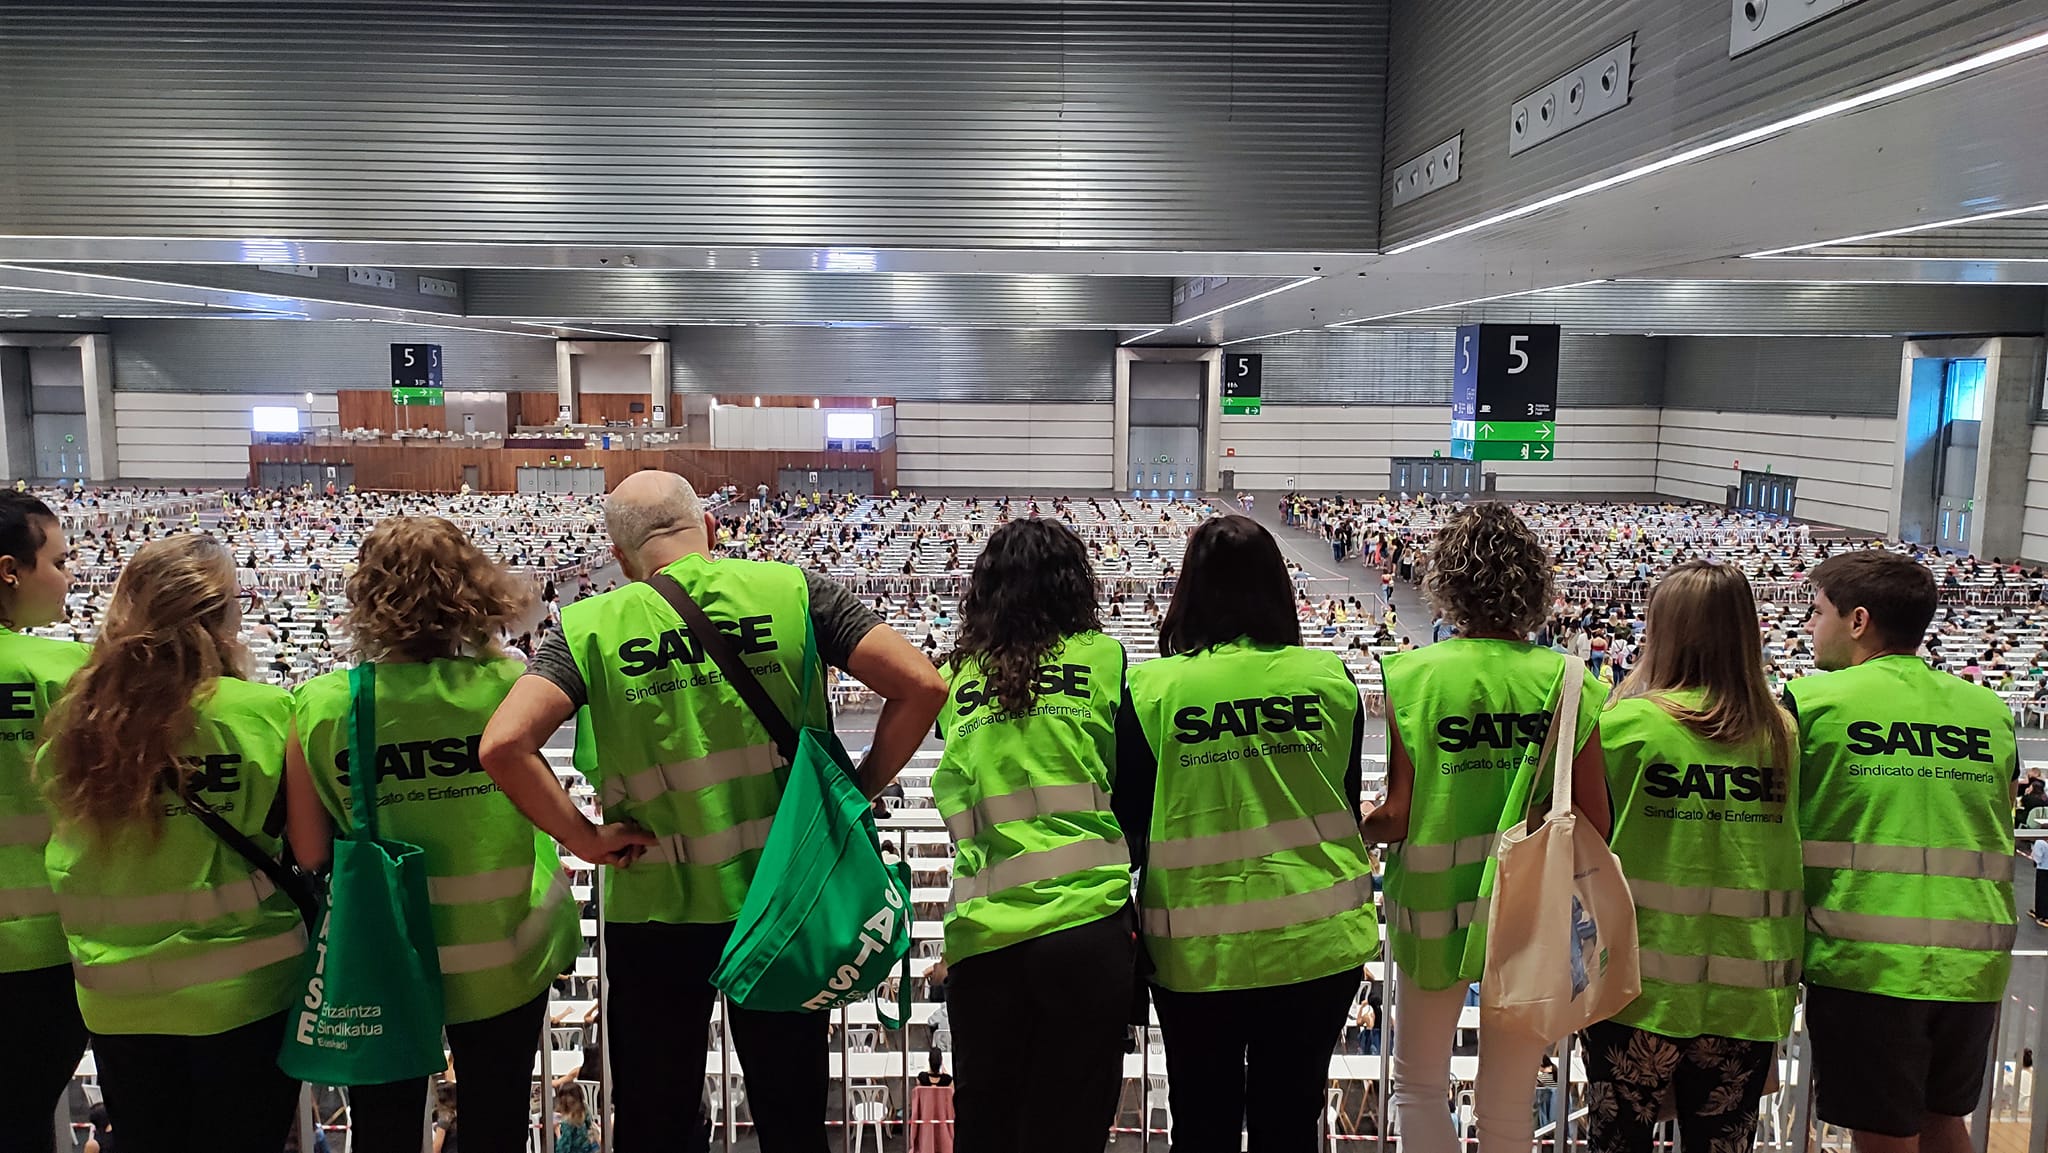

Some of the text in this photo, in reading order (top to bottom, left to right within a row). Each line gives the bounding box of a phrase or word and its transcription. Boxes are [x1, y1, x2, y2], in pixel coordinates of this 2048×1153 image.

[404, 348, 415, 367] 5
[432, 349, 438, 367] 5
[1461, 335, 1471, 375] 5
[1507, 335, 1529, 374] 5
[1238, 358, 1249, 376] 5
[1527, 403, 1534, 416] 3
[122, 495, 131, 505] 10
[1364, 507, 1372, 517] 18
[625, 677, 688, 702] Sindicato
[690, 674, 707, 687] de
[957, 710, 1007, 738] Sindicato
[1028, 703, 1092, 719] Enfermería
[1173, 694, 1323, 744] SATSE
[1846, 721, 1994, 763] SATSE
[1180, 741, 1323, 767] Sindicato de Enfermería
[1441, 757, 1493, 775] Sindicato
[1497, 757, 1511, 769] de
[1849, 764, 1994, 784] Sindicato de Enfermería
[407, 789, 425, 801] de
[1643, 806, 1704, 820] Sindicato
[1706, 809, 1722, 821] de
[317, 1019, 383, 1037] Sindikatua
